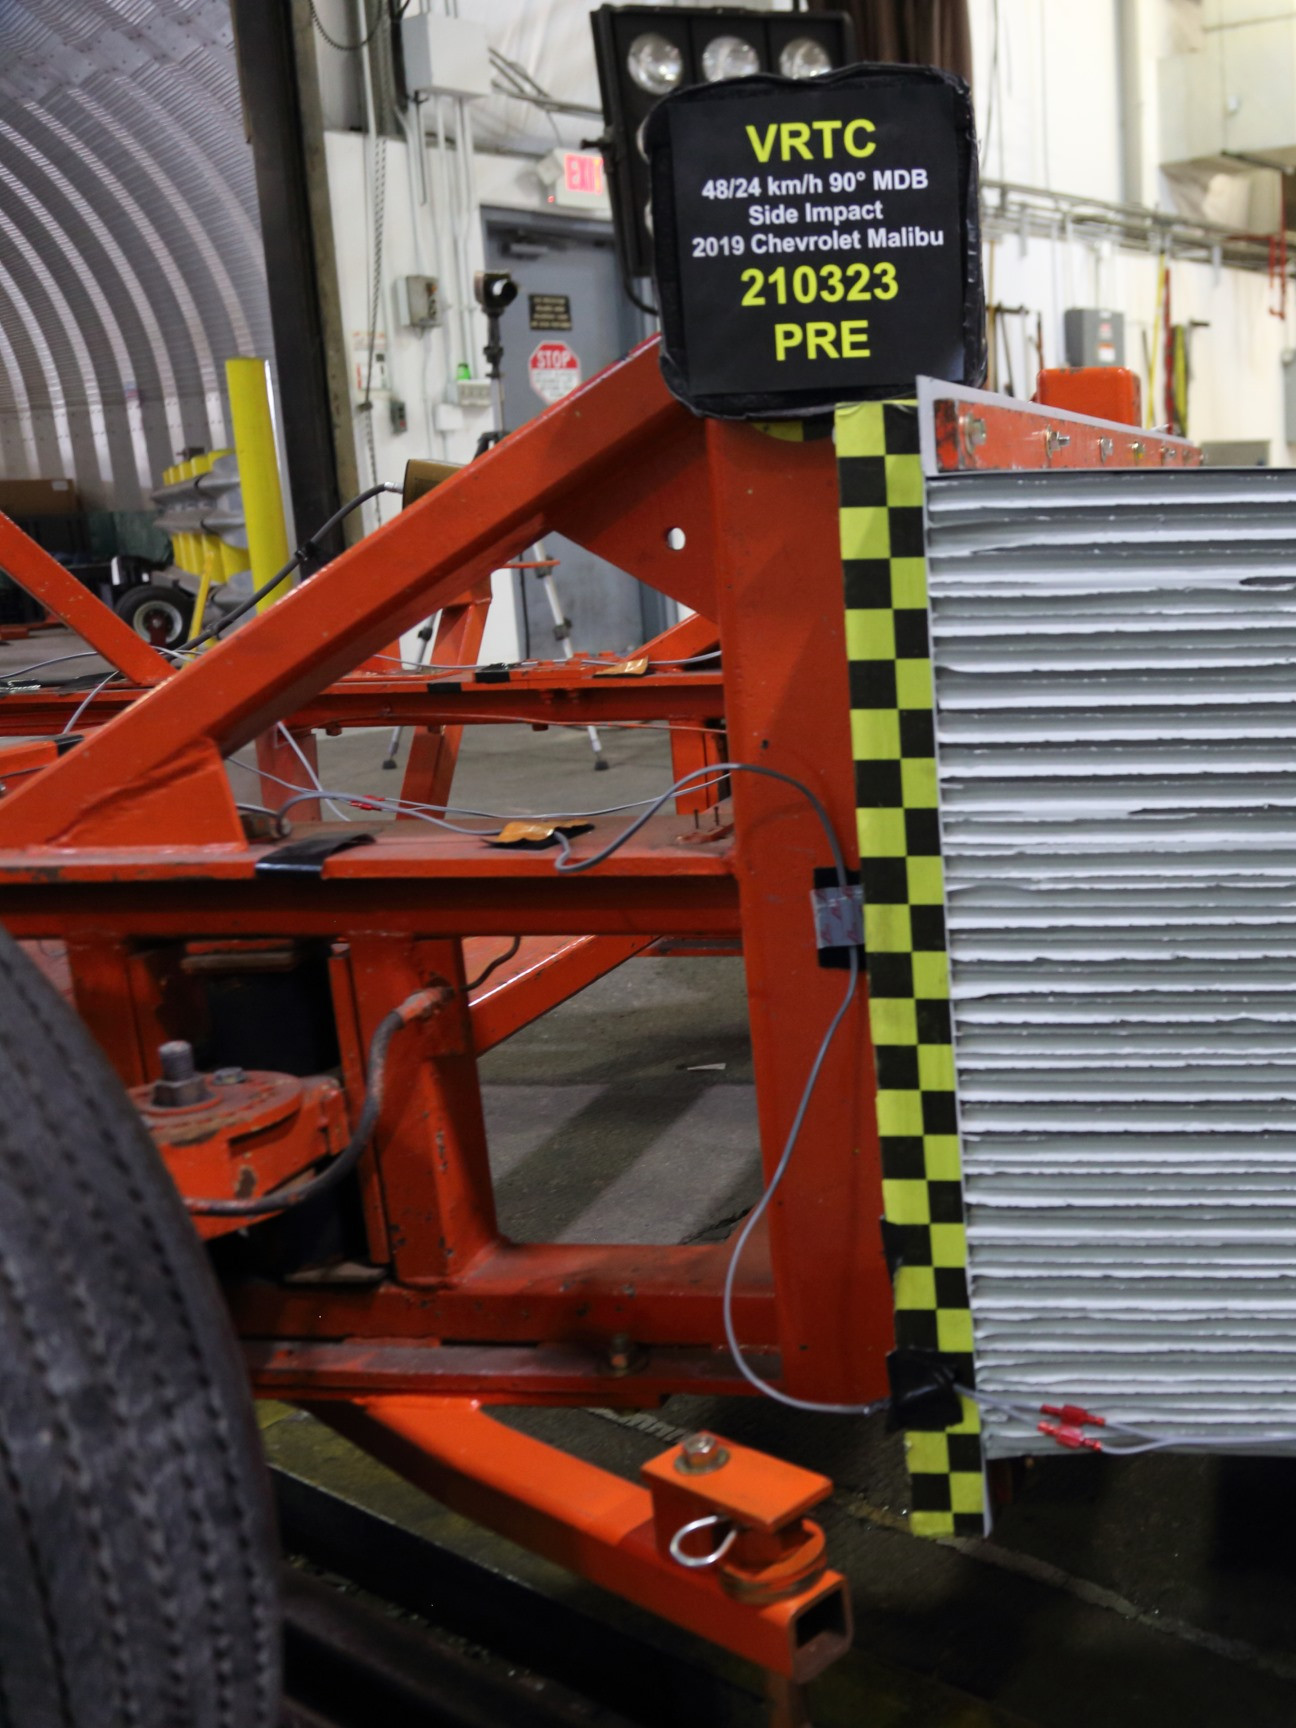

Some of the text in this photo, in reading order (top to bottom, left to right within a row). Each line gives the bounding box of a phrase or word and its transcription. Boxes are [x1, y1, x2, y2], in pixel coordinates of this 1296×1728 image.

[746, 119, 877, 162] VRTC
[564, 154, 604, 193] EXIT
[702, 168, 928, 200] 48/24 km/h 90° MDB
[749, 200, 883, 226] Side Impact
[692, 226, 944, 257] 2019 Chevrolet Malibu
[741, 262, 899, 306] 210323
[774, 320, 871, 361] PRE
[537, 350, 571, 369] STOP
